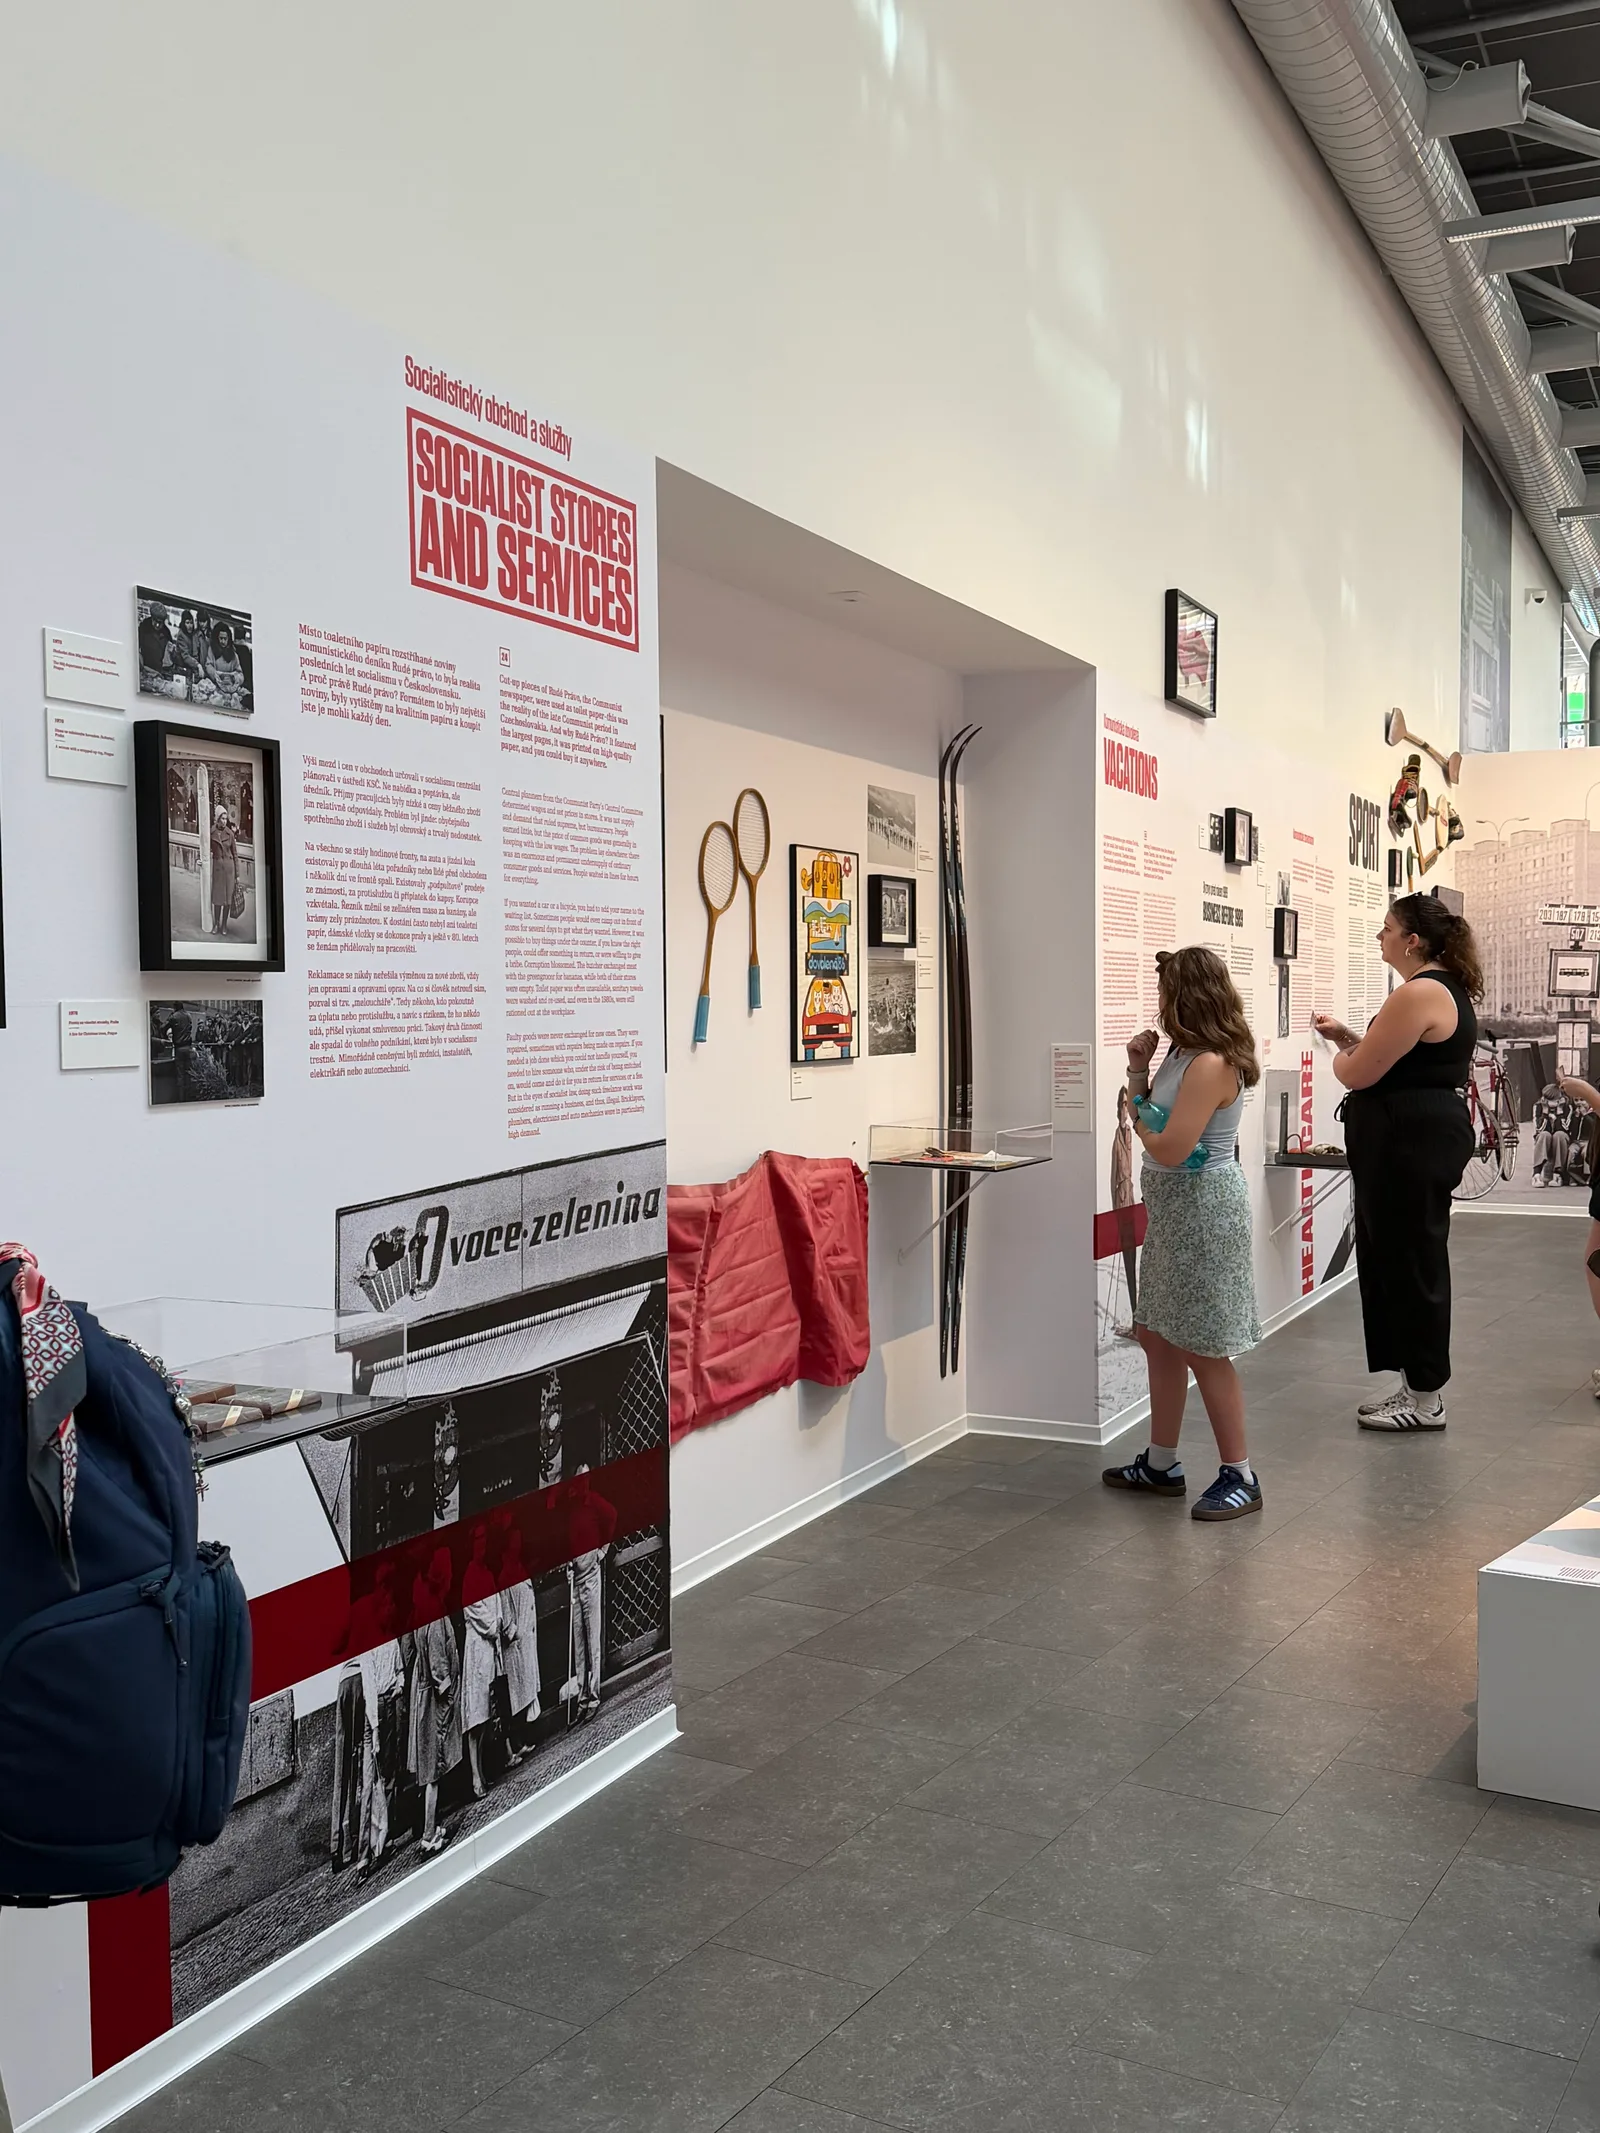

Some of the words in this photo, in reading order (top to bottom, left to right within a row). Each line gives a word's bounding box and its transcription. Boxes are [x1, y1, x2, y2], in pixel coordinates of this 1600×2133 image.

[405, 355, 483, 422] Socialistický
[485, 395, 527, 438] obchod
[530, 419, 537, 443] a
[539, 420, 572, 461] služby
[416, 428, 545, 533] SOCIALIST
[550, 483, 631, 566] STORES
[419, 494, 489, 591] AND
[497, 523, 632, 637] SERVICES
[298, 624, 322, 638] Místo
[323, 631, 364, 648] toaletního
[365, 642, 390, 655] papíru
[434, 660, 456, 674] noviny
[299, 639, 363, 663] komunistického
[364, 655, 390, 670] deníku
[392, 661, 411, 674] Rudé
[412, 668, 434, 681] právo,
[435, 672, 442, 682] to
[443, 673, 458, 686] byla
[459, 679, 480, 690] realita
[300, 656, 344, 673] posledních
[345, 664, 356, 676] let
[357, 670, 397, 685] socialismu
[403, 677, 461, 699] Československu.
[300, 670, 307, 681] A
[308, 673, 327, 684] proč
[328, 678, 350, 690] právě
[352, 681, 372, 694] Rudé
[373, 688, 398, 700] právo?
[399, 691, 435, 708] Formátem
[436, 700, 444, 710] to
[444, 700, 459, 715] byly
[300, 687, 329, 702] noviny,
[331, 691, 348, 706] byly
[384, 704, 394, 713] na
[395, 704, 429, 720] kvalitním
[430, 714, 453, 726] papíru
[301, 700, 316, 713] jste
[318, 704, 325, 716] je
[327, 707, 349, 719] mohli
[350, 710, 374, 726] každý
[375, 715, 391, 727] den.
[1104, 737, 1158, 800] VACATIONS
[1349, 793, 1380, 872] SPORT
[1539, 909, 1552, 920] 203
[1592, 911, 1600, 922] 15
